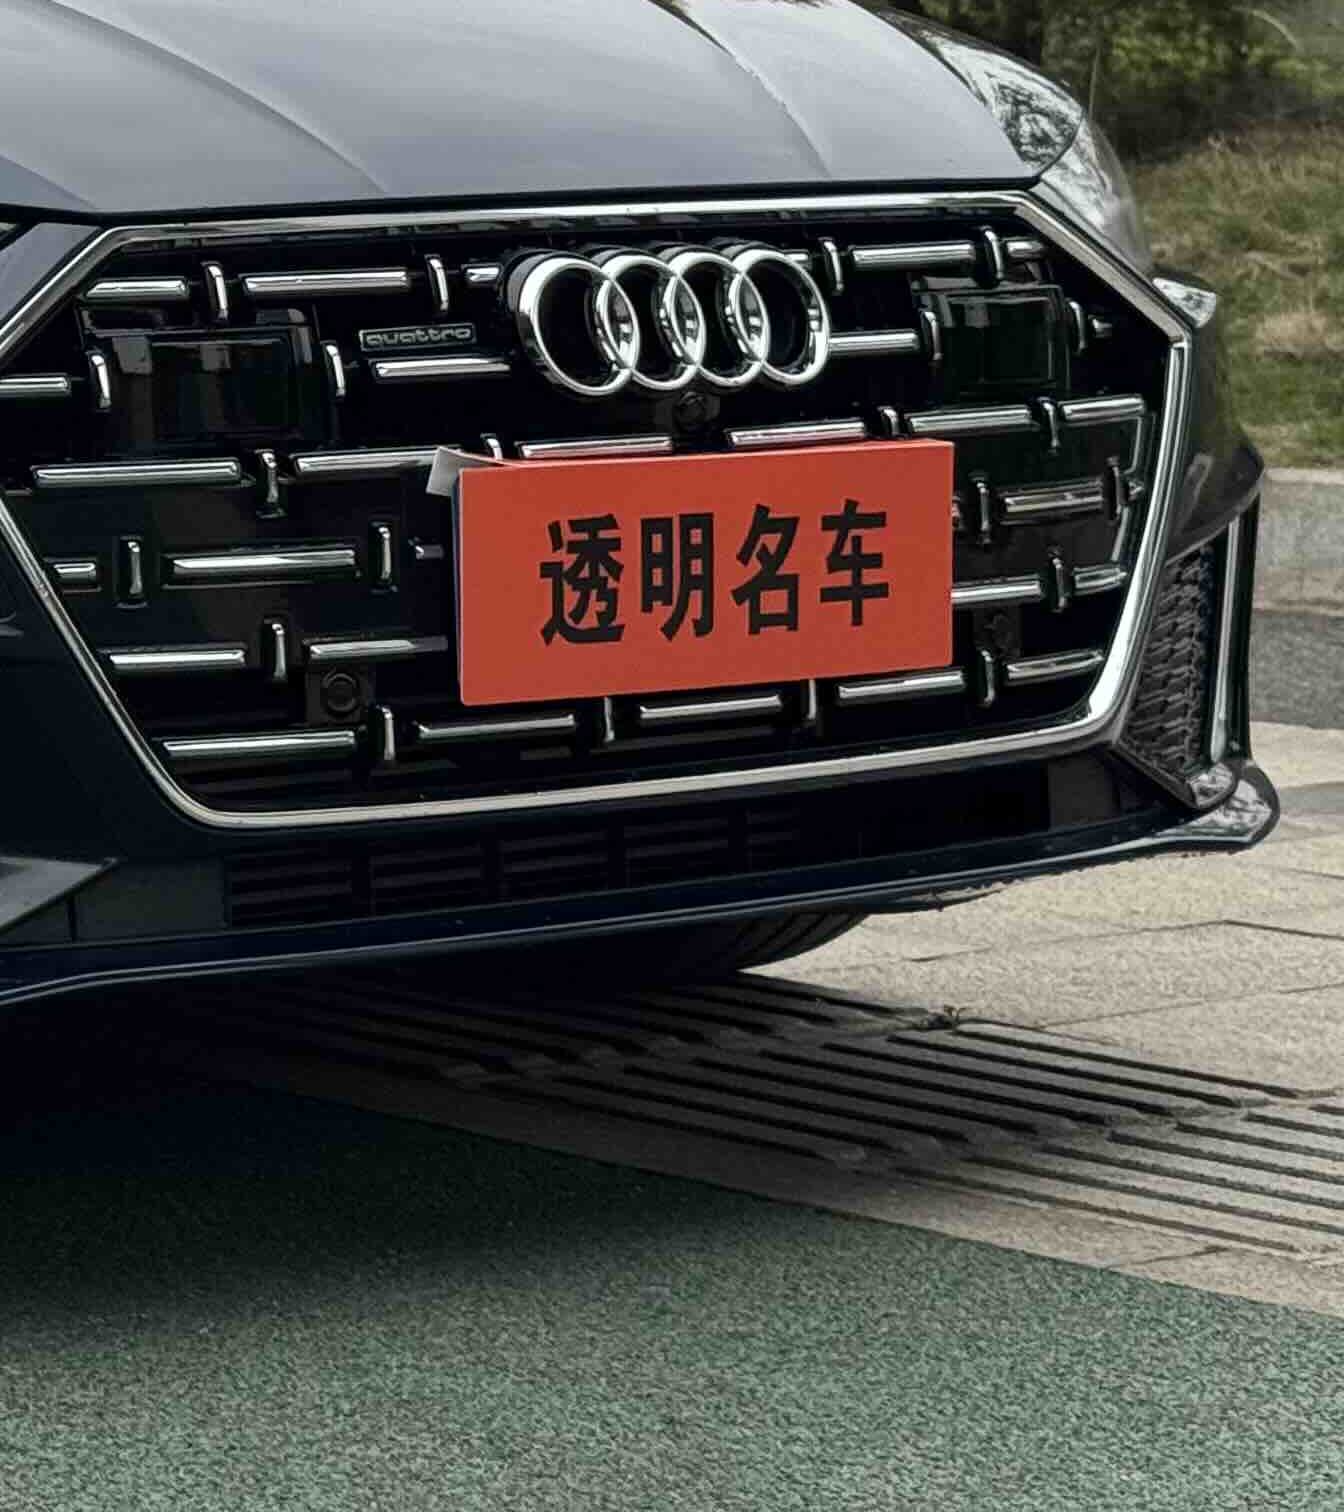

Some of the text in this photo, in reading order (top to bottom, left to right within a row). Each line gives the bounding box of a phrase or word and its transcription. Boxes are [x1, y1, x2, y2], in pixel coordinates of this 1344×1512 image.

[366, 328, 472, 346] quattro
[539, 498, 890, 645] 透明名车
